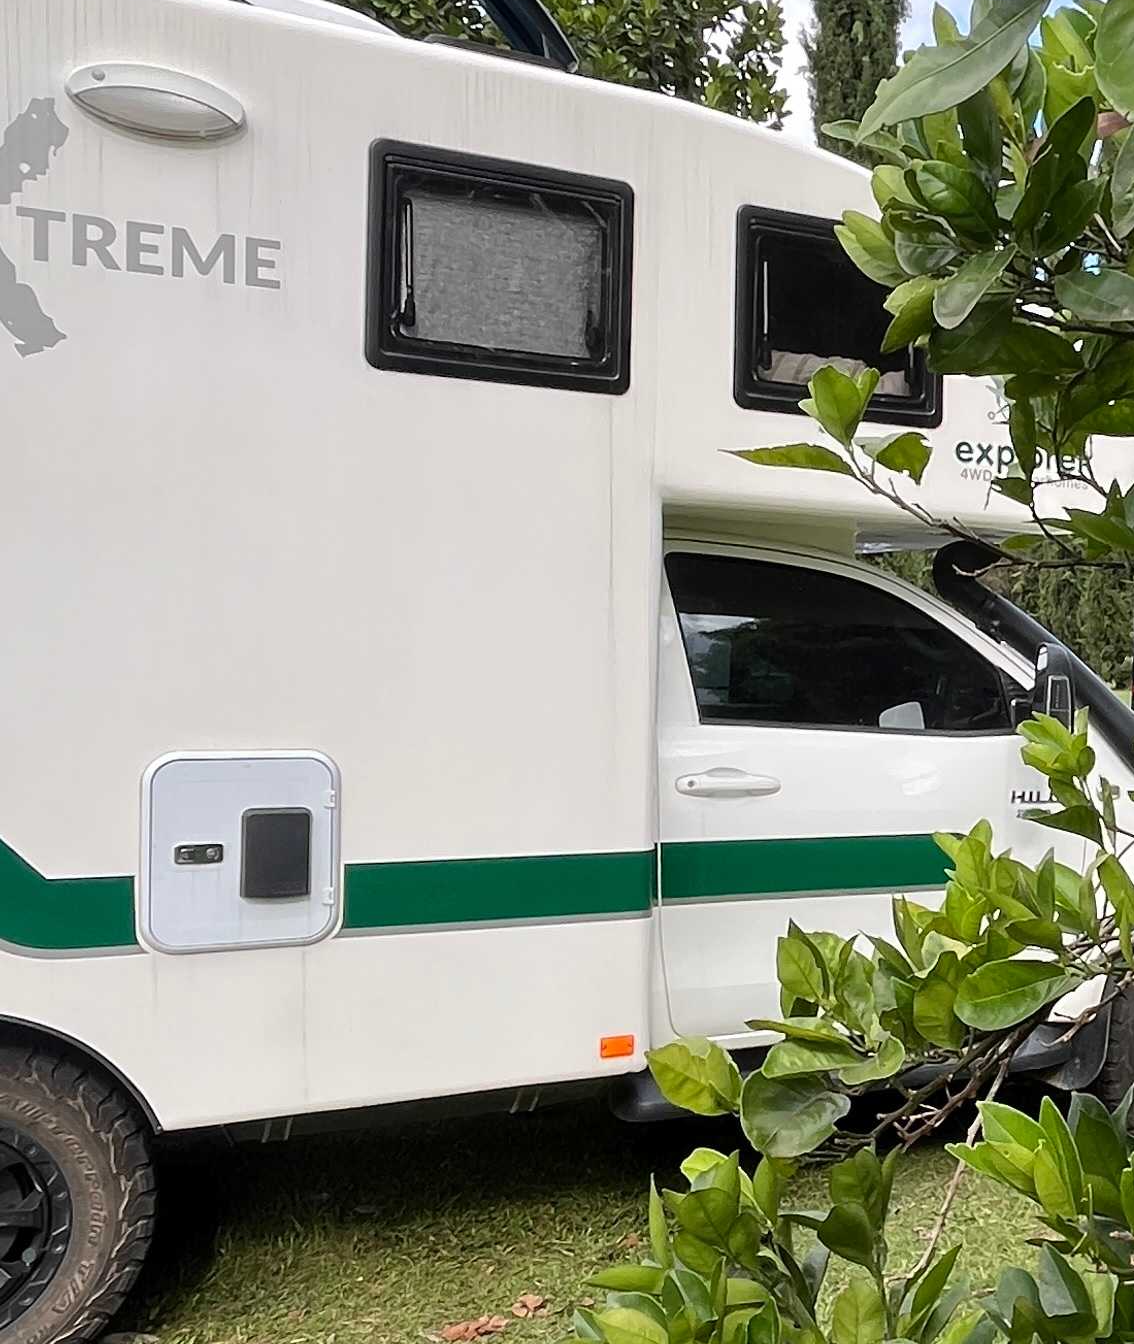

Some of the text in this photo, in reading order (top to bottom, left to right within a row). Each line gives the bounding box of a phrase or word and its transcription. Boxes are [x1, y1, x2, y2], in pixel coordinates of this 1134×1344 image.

[955, 441, 1088, 475] exporer
[960, 468, 993, 482] 4WD
[1011, 790, 1056, 804] HIL
